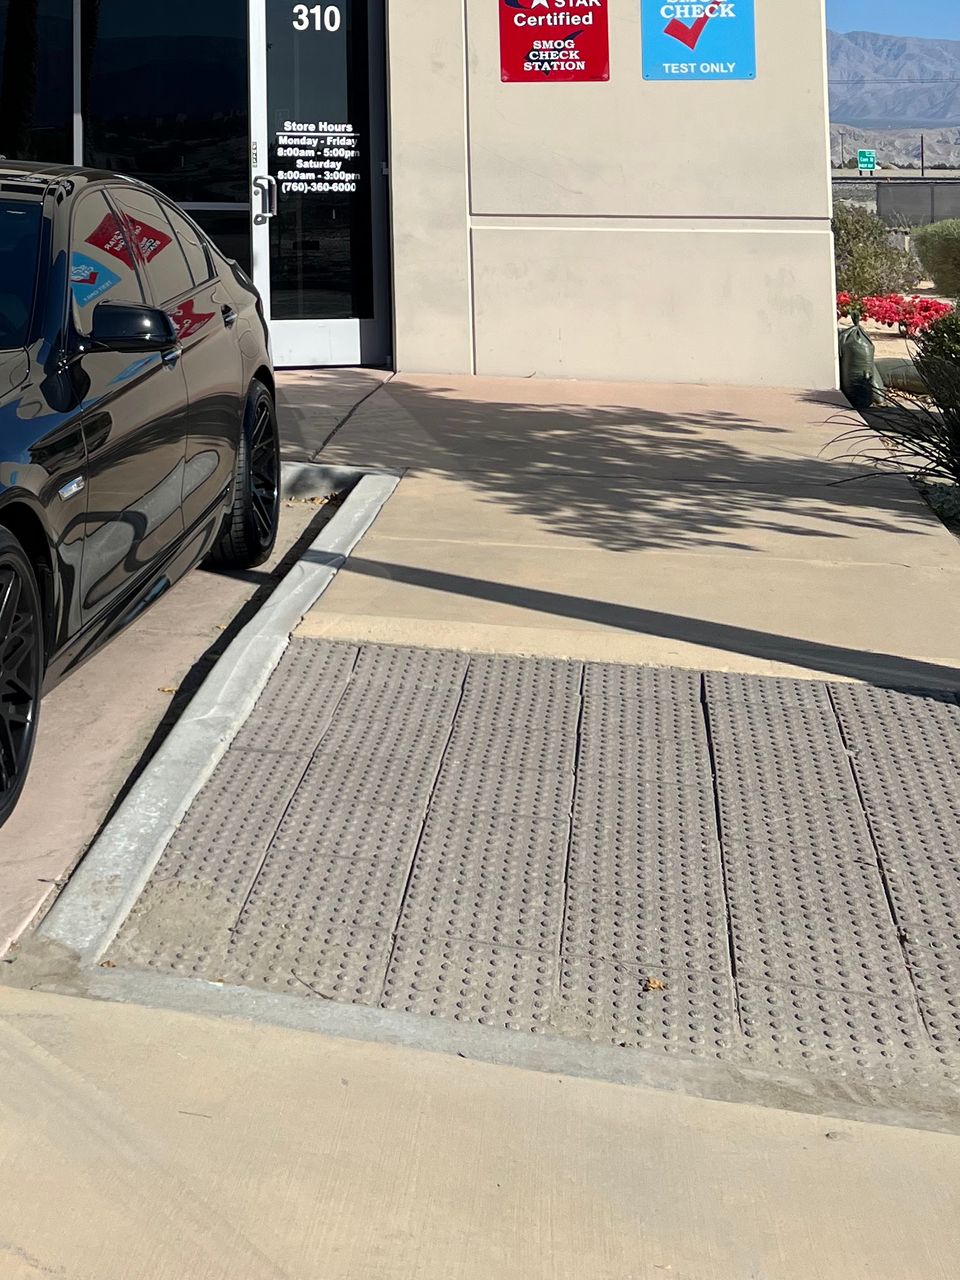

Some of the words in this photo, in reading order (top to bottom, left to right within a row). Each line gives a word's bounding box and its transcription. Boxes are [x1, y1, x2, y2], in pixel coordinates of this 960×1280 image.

[660, 3, 736, 18] CHECK
[292, 4, 341, 32] 310
[513, 11, 593, 27] Certified
[533, 39, 575, 50] SMOG
[528, 50, 580, 60] CHECK
[523, 61, 586, 71] STATION
[663, 63, 696, 73] TEST
[700, 62, 736, 73] ONLY
[284, 121, 316, 131] Store
[318, 122, 353, 132] Hours
[279, 136, 318, 147] Monday
[326, 136, 357, 147] Friday
[277, 147, 315, 157] 8:00am
[323, 148, 360, 160] 5:00pm
[296, 159, 342, 170] Saturday
[277, 170, 315, 180] 8:00am
[323, 171, 360, 182] 3:00pm
[281, 182, 356, 193] (760)-360-6000
